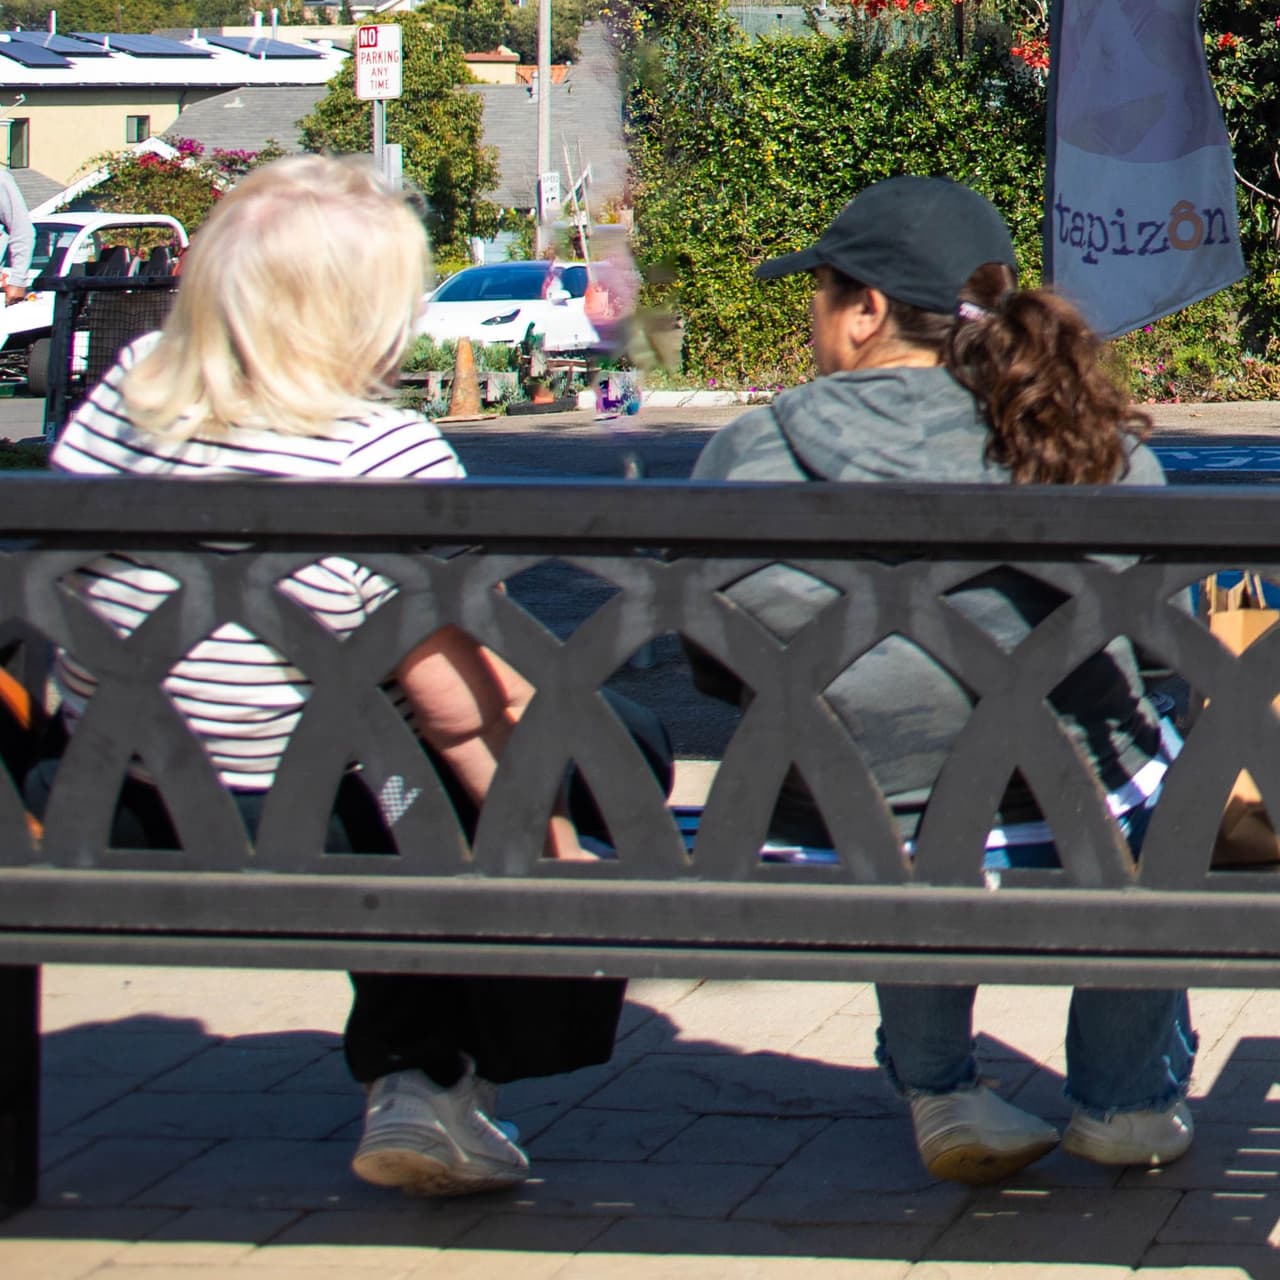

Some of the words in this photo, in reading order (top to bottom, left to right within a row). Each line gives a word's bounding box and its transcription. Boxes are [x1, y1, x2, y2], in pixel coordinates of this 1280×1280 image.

[360, 29, 376, 46] NO
[360, 49, 399, 64] PARKING
[371, 67, 388, 77] ANY
[370, 79, 389, 90] TIME
